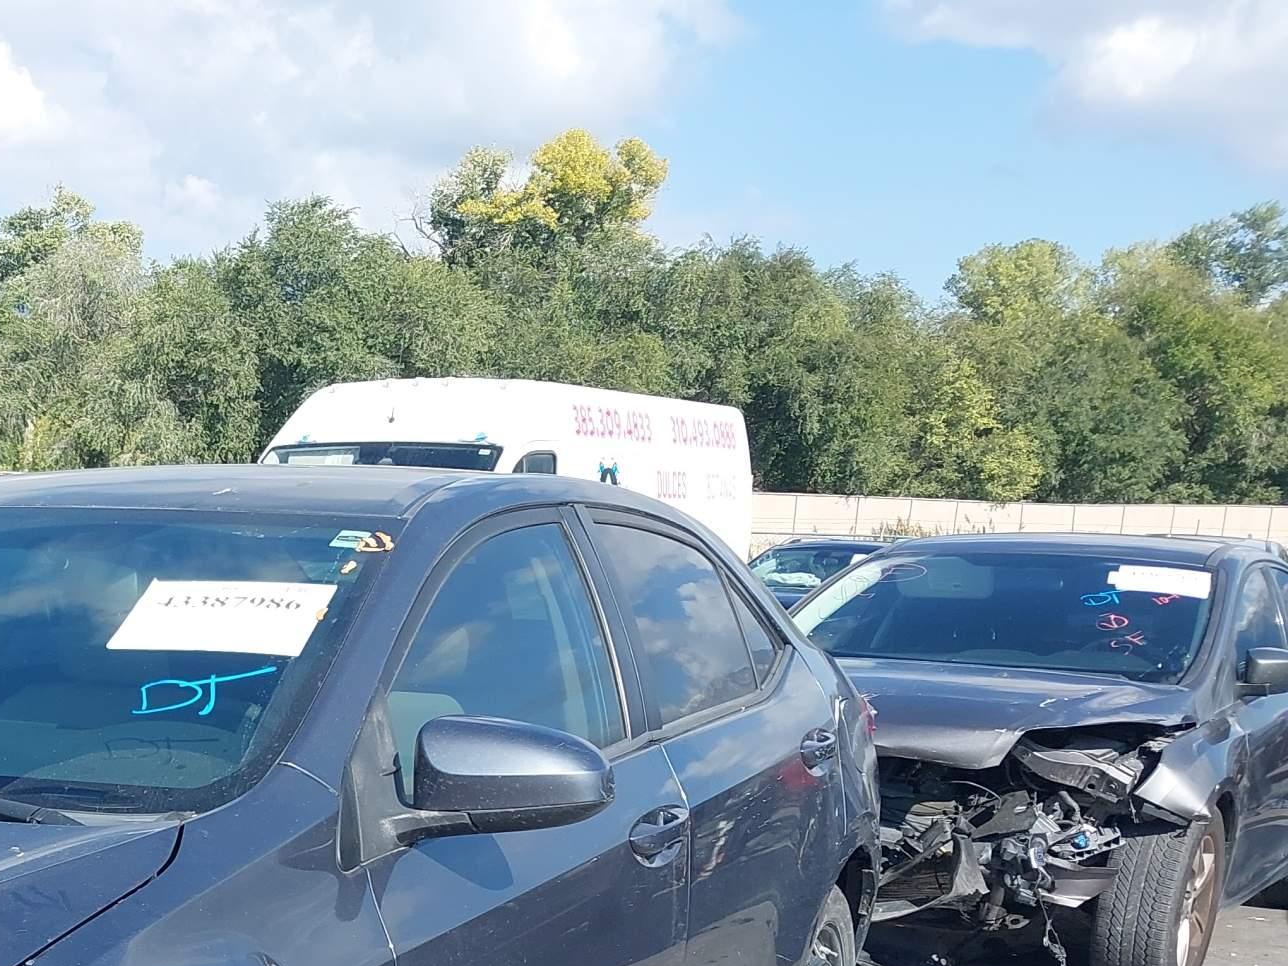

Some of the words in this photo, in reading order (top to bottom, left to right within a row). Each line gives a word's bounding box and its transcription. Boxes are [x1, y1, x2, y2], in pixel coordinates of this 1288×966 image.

[573, 404, 653, 444] 385.309.4833
[656, 470, 688, 499] DULCES
[157, 596, 302, 611] 43387986
[132, 666, 278, 716] DT
